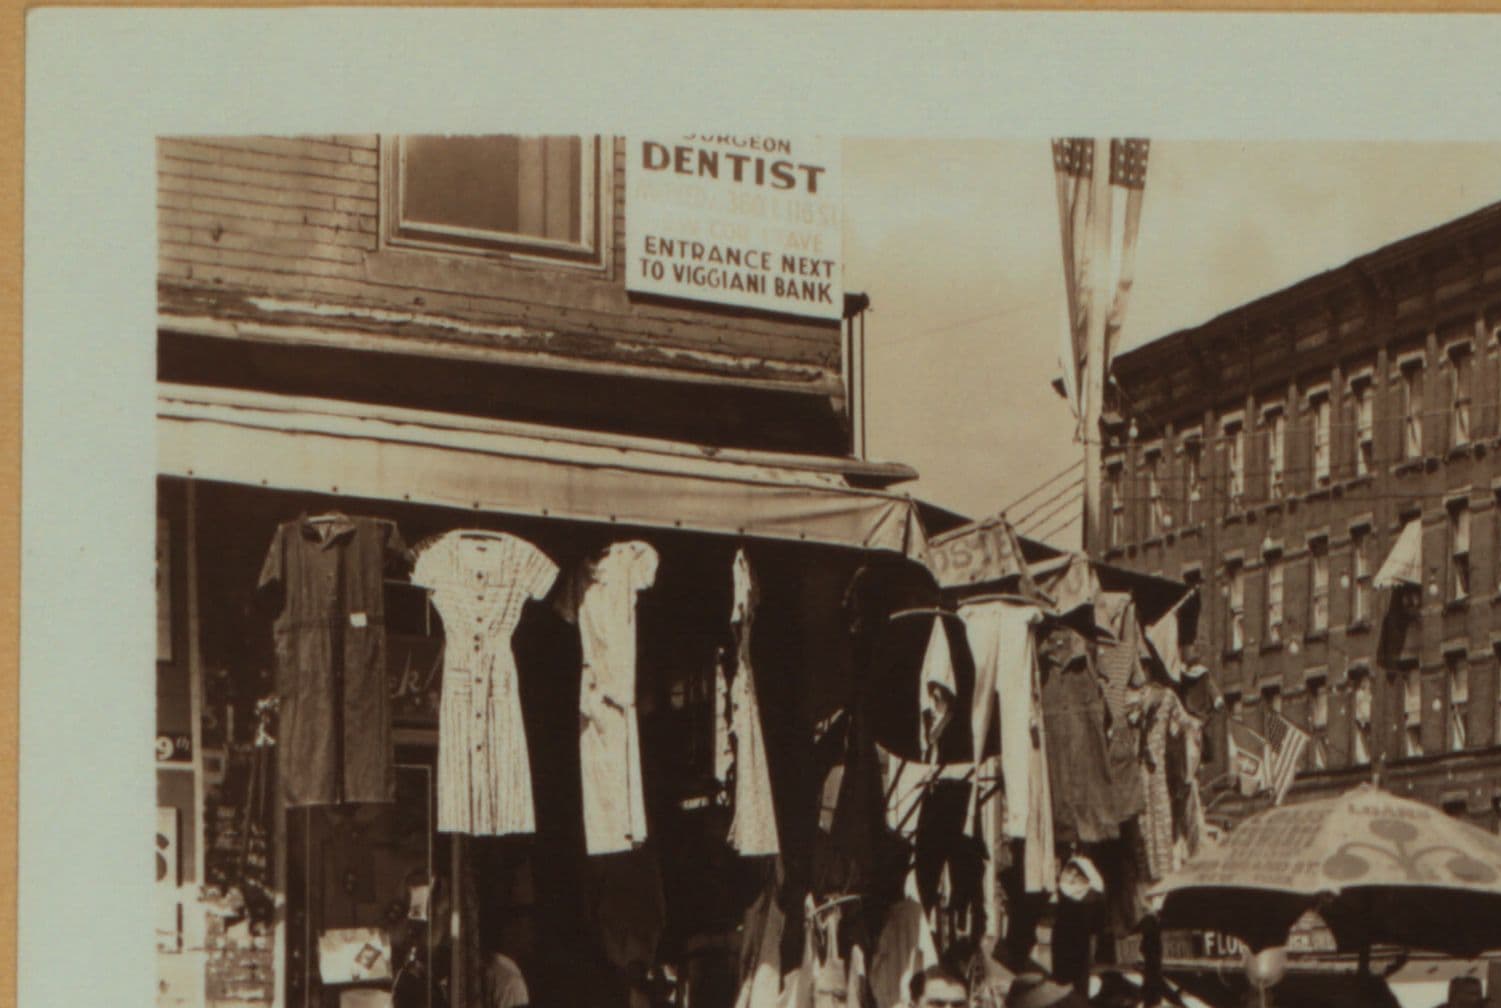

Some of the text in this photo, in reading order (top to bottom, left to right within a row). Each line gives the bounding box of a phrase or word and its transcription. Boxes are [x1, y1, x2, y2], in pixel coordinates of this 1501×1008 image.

[642, 140, 827, 195] DENTIST
[639, 257, 834, 305] TO VIGGIANI BANK
[644, 235, 773, 272] ENTRANCE
[780, 254, 836, 280] NEXT
